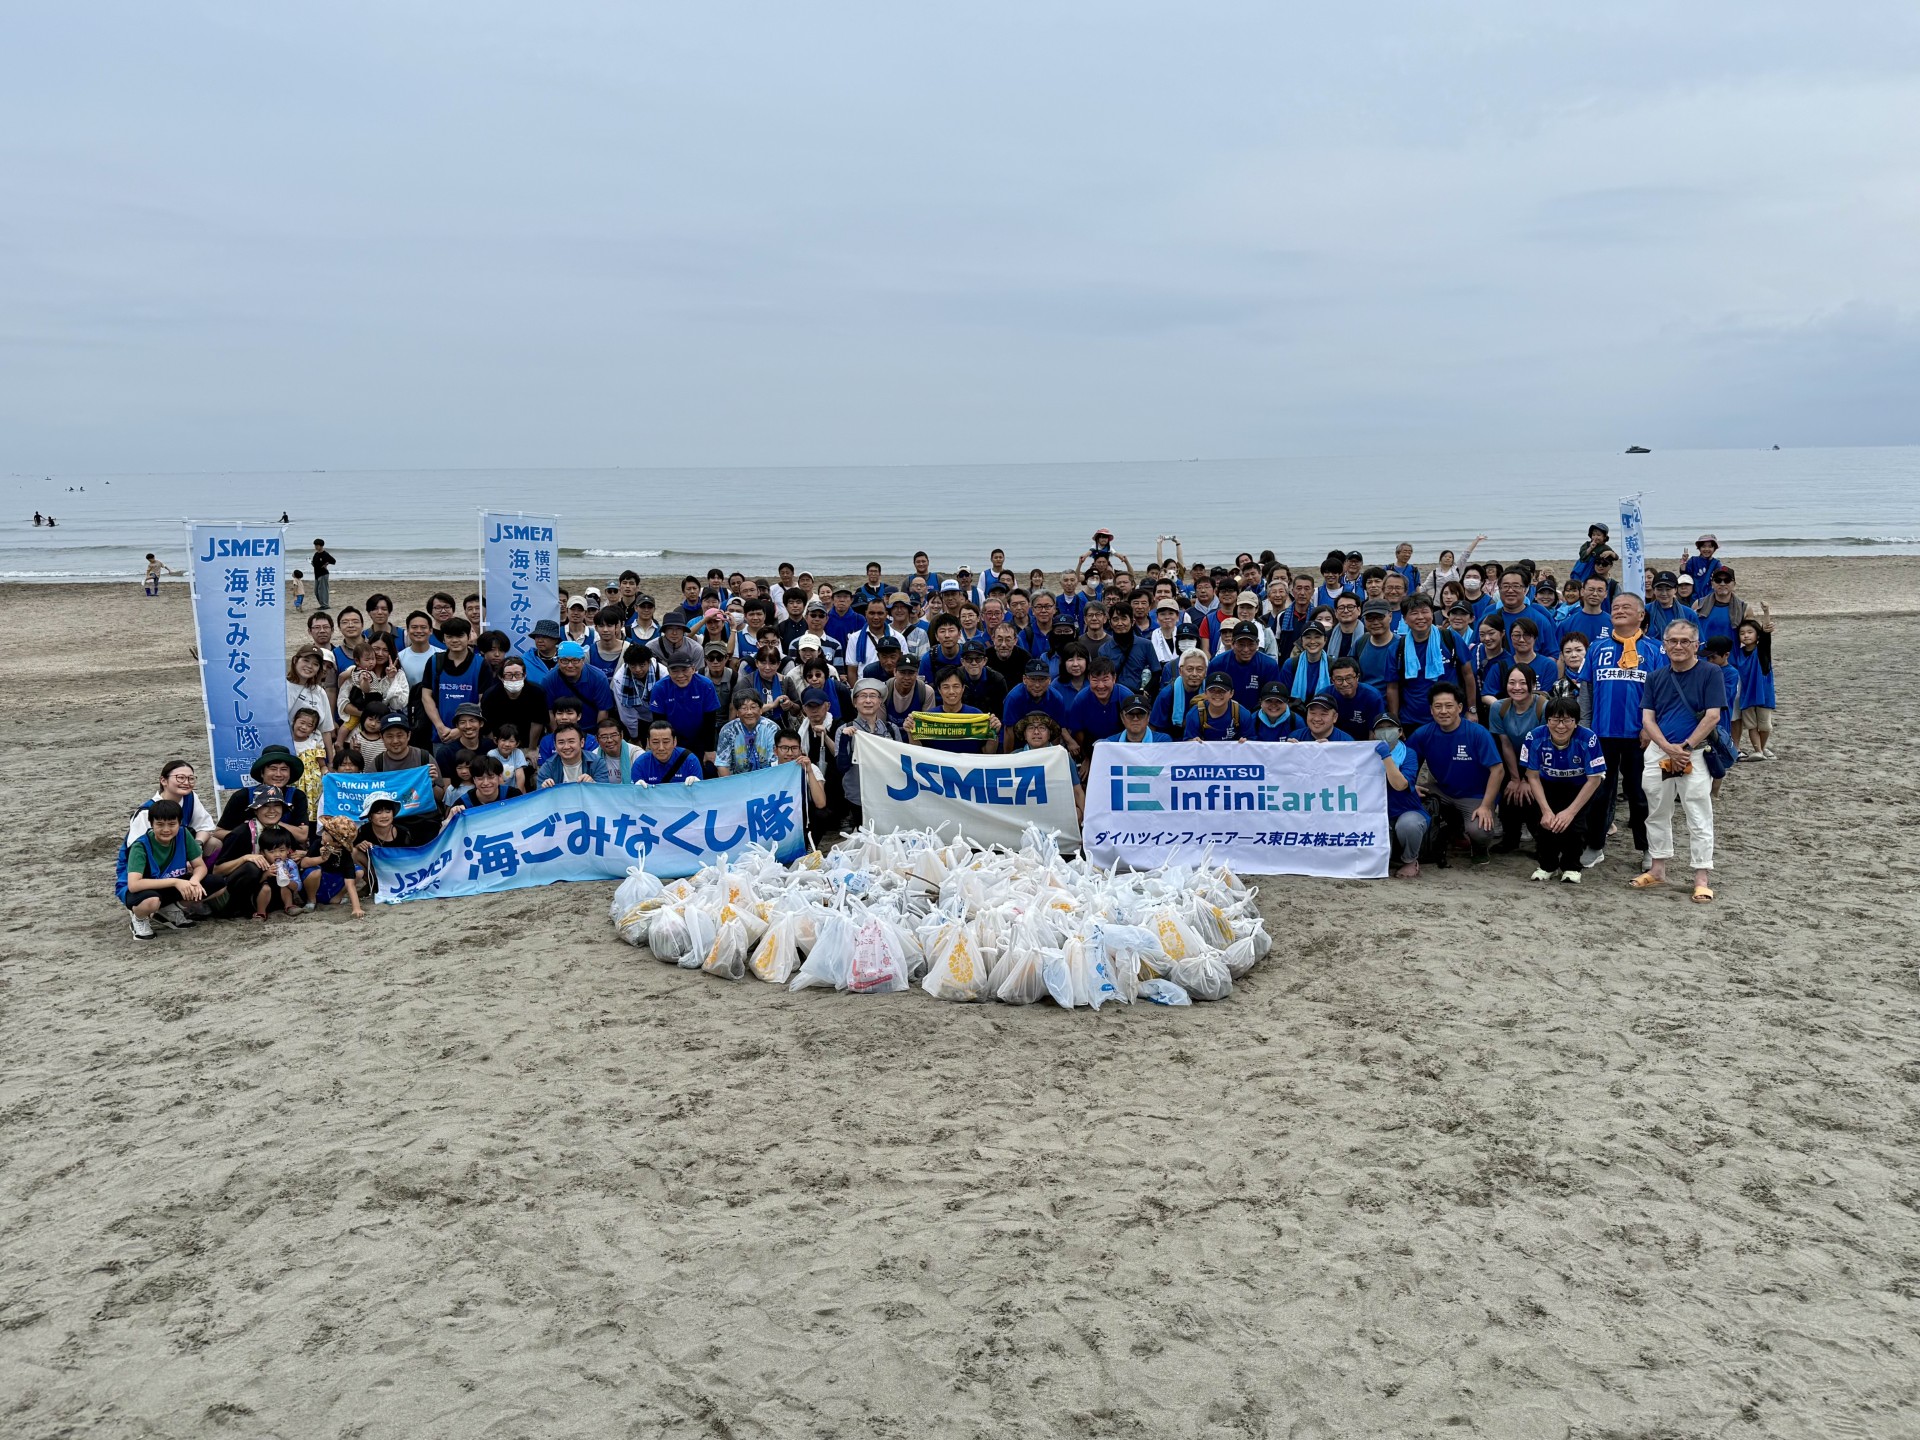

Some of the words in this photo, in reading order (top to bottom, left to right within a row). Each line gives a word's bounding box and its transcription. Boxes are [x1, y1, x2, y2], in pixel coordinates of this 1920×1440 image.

[490, 523, 553, 543] JSMEA
[201, 537, 280, 562] JSMEA
[534, 550, 551, 582] 横浜
[255, 566, 276, 607] 横浜
[224, 567, 261, 751] 海ごみなくし隊
[1598, 651, 1613, 666] 12
[1607, 669, 1646, 681] 共創未来
[224, 757, 256, 771] 海ご
[1175, 767, 1260, 779] DAIHATSU
[335, 780, 369, 789] DAIKIN
[371, 780, 386, 789] MR
[886, 753, 1048, 806] JSMEA
[337, 791, 398, 801] ENGING
[1171, 784, 1358, 812] InfiniEarth
[463, 790, 795, 881] 海ごみなくし隊
[1095, 831, 1375, 847] ダイハツインフィニアース東日本株式会社
